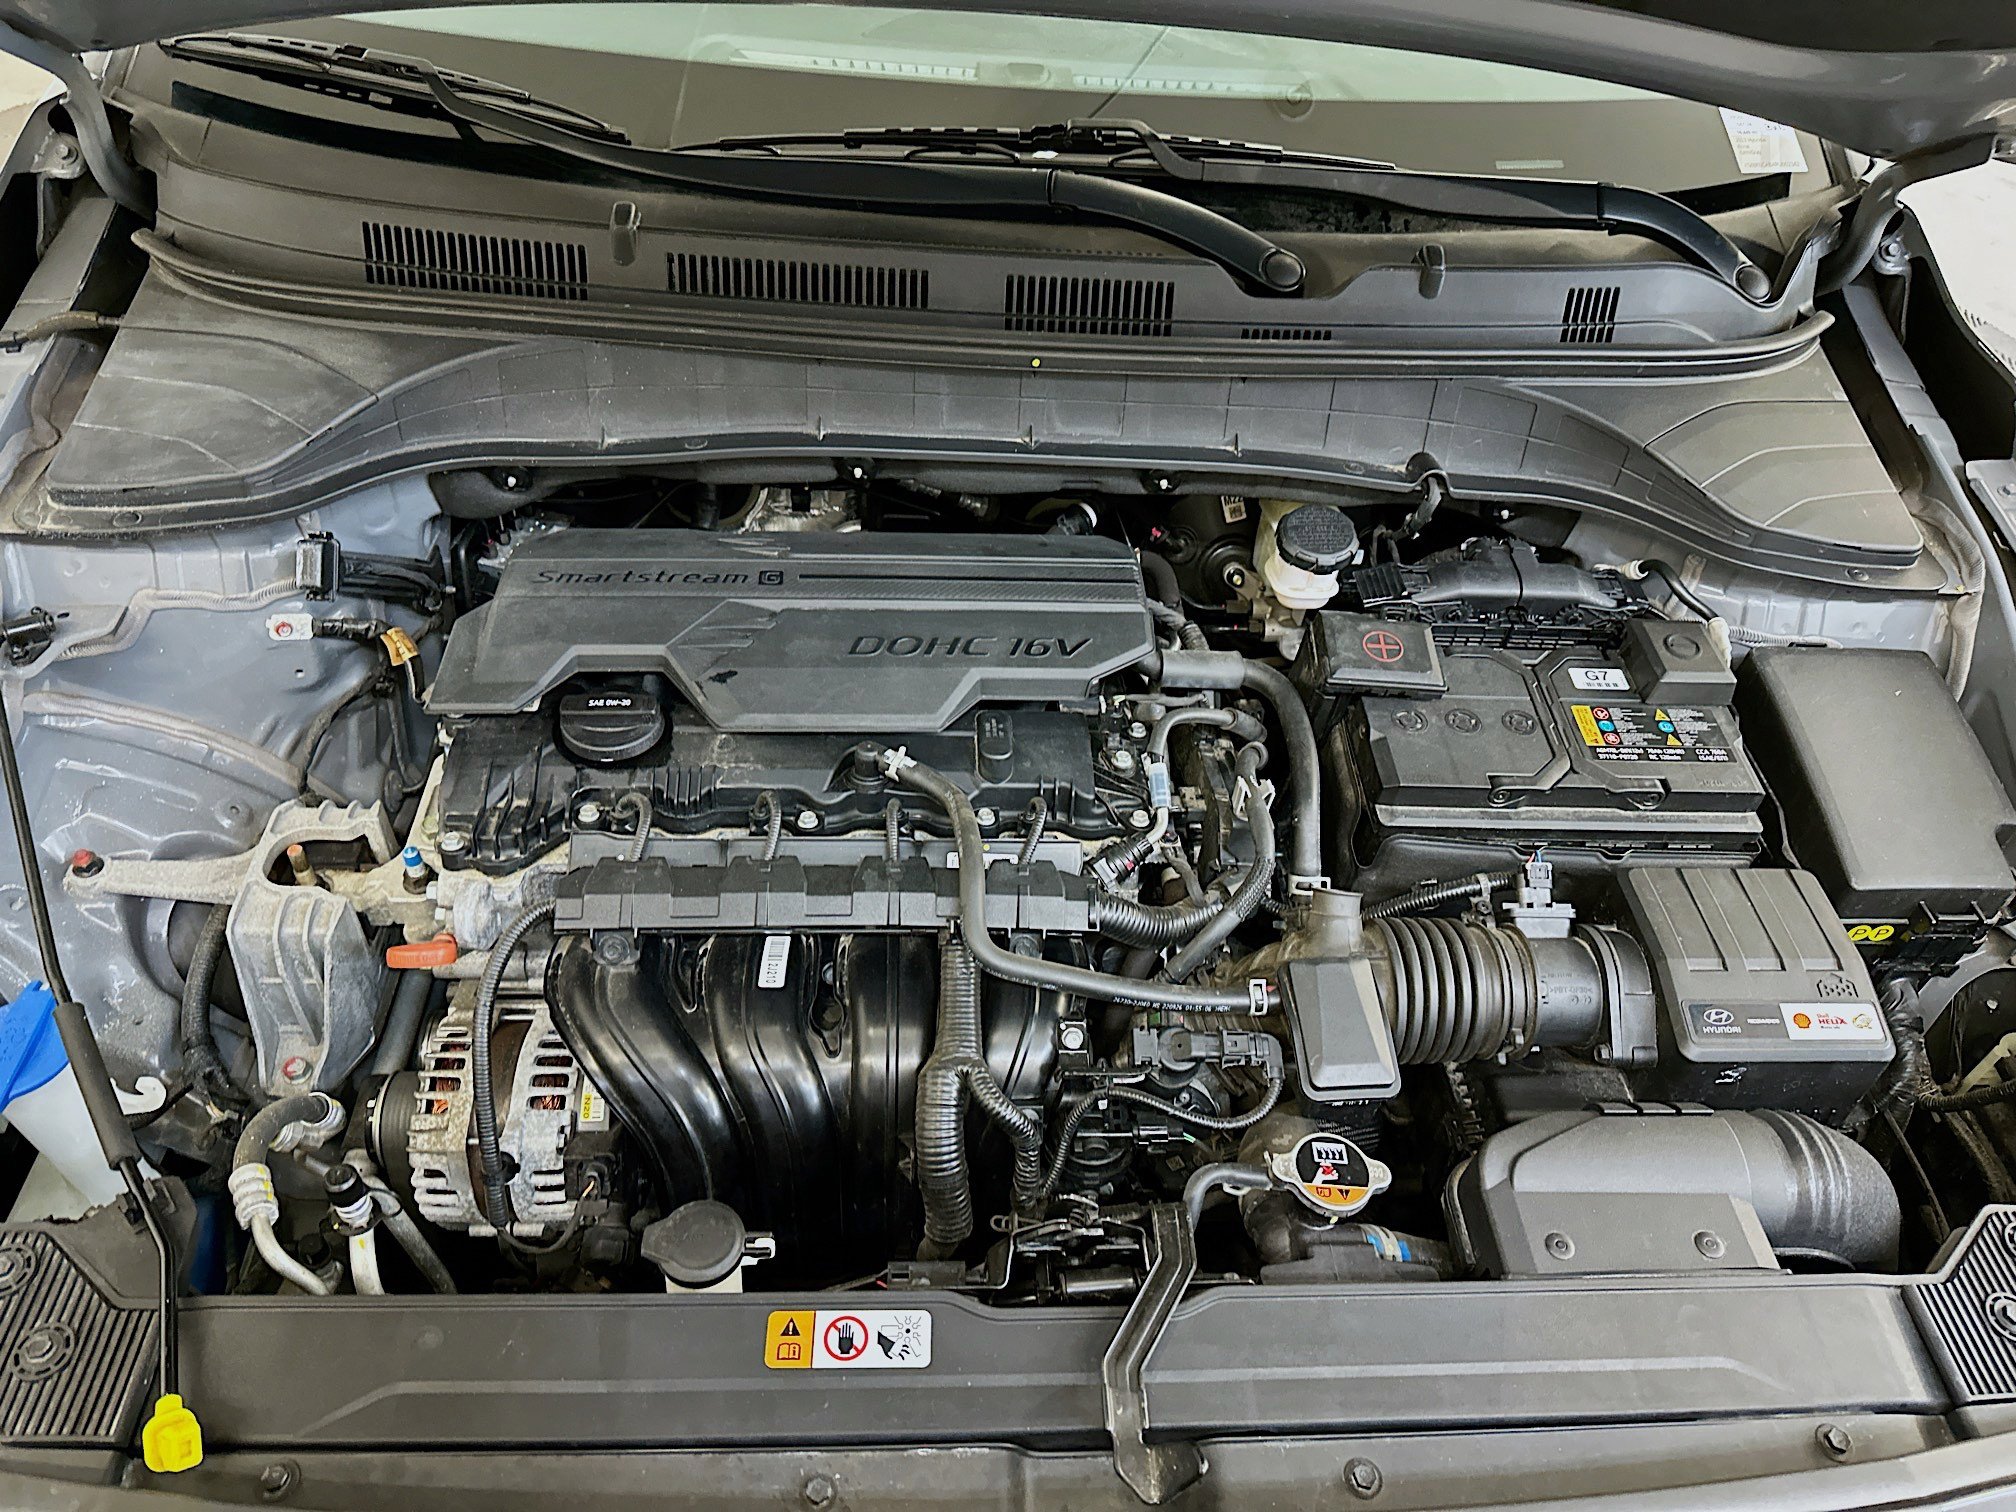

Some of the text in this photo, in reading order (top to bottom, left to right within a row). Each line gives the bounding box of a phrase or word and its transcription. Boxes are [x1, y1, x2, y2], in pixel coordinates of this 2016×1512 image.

[532, 569, 750, 585] Smartstream
[848, 635, 1093, 658] DOHC 16V
[1585, 670, 1608, 681] G7
[588, 698, 631, 707] SAE 0W-20
[765, 963, 779, 984] 2J210
[1818, 1017, 1848, 1025] HELIX
[1702, 1026, 1742, 1034] HYUNDAI
